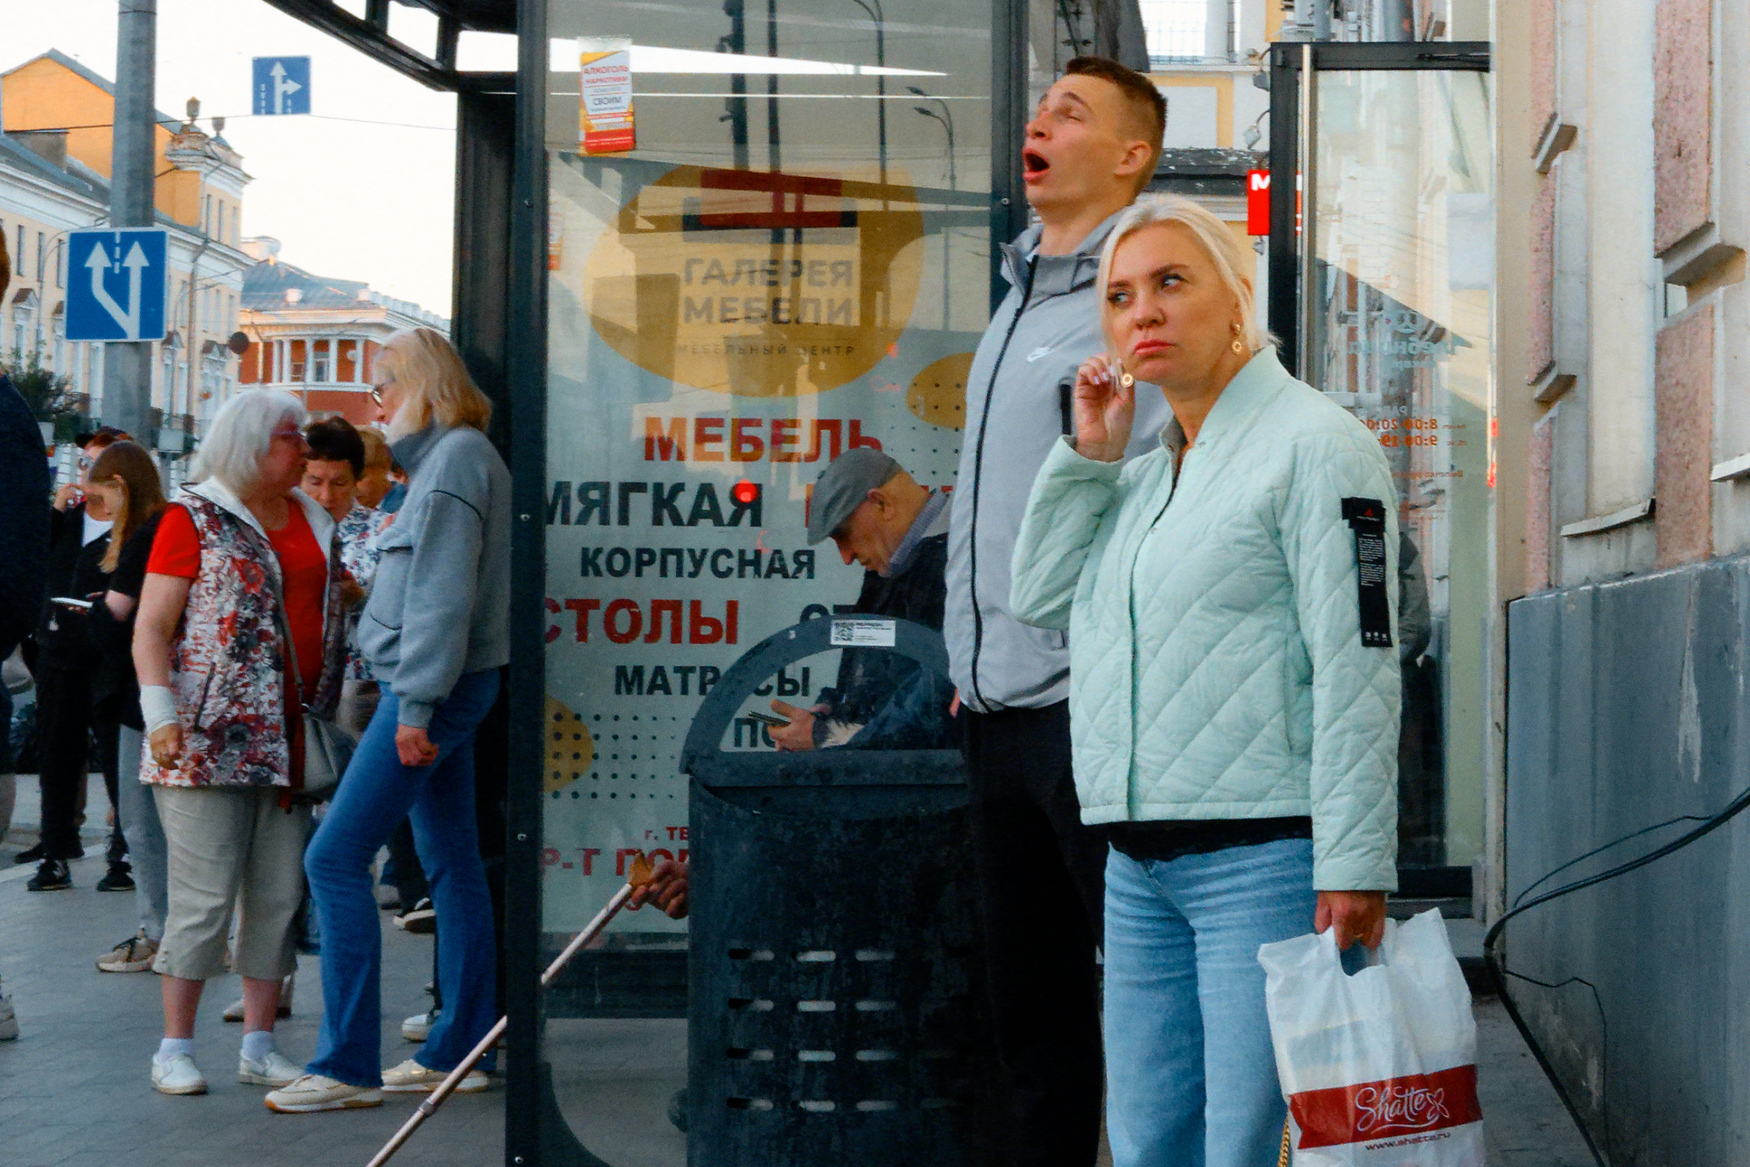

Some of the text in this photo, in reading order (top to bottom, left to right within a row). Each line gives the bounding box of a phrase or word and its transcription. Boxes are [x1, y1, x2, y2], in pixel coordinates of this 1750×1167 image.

[583, 65, 629, 75] АЛКОГОЛЬ
[592, 97, 621, 106] СВОИМ
[684, 258, 853, 287] ГАЛЕРЕЯ
[683, 296, 852, 325] МЕБЕЛИ
[644, 417, 883, 462] МЕБЕЛЬ
[546, 481, 762, 527] МЯГКАЯ
[580, 547, 815, 579] КОРПУСНАЯ
[544, 598, 740, 645] СТОЛЫ
[615, 665, 811, 697] МАТРЫ
